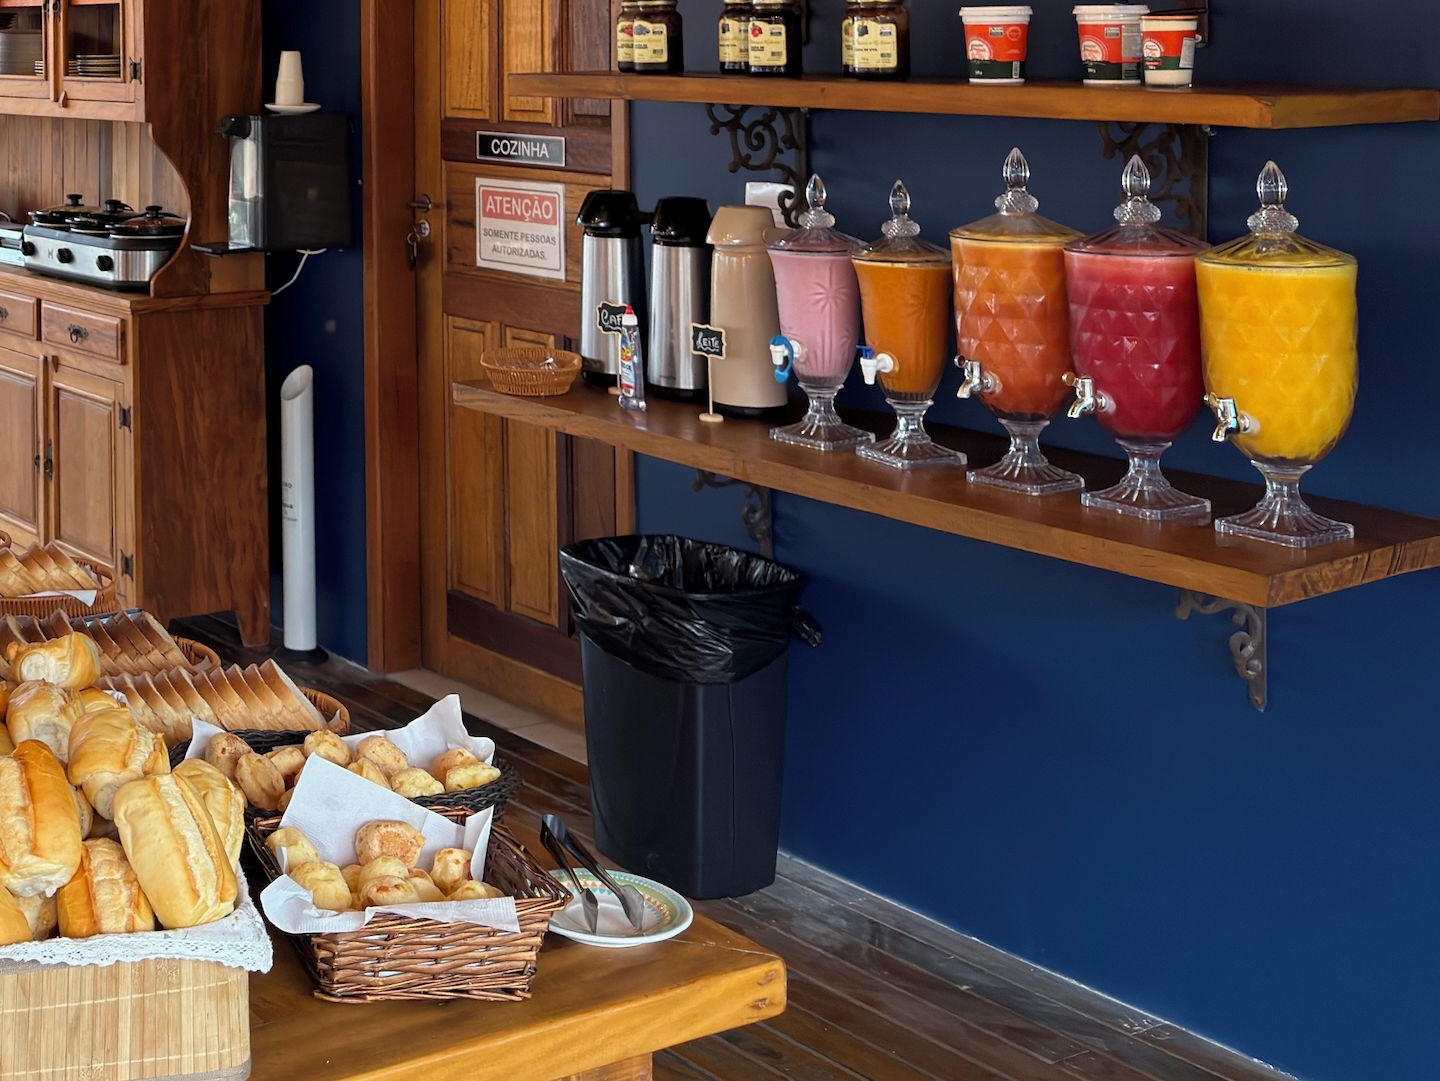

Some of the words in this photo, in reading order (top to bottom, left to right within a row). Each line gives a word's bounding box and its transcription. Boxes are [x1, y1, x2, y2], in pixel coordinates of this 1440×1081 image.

[491, 139, 549, 158] COZINHA
[486, 195, 553, 221] ATENÇÃO
[483, 227, 519, 241] SOMENTE
[520, 232, 556, 246] PESSOAS
[601, 309, 623, 326] CAF
